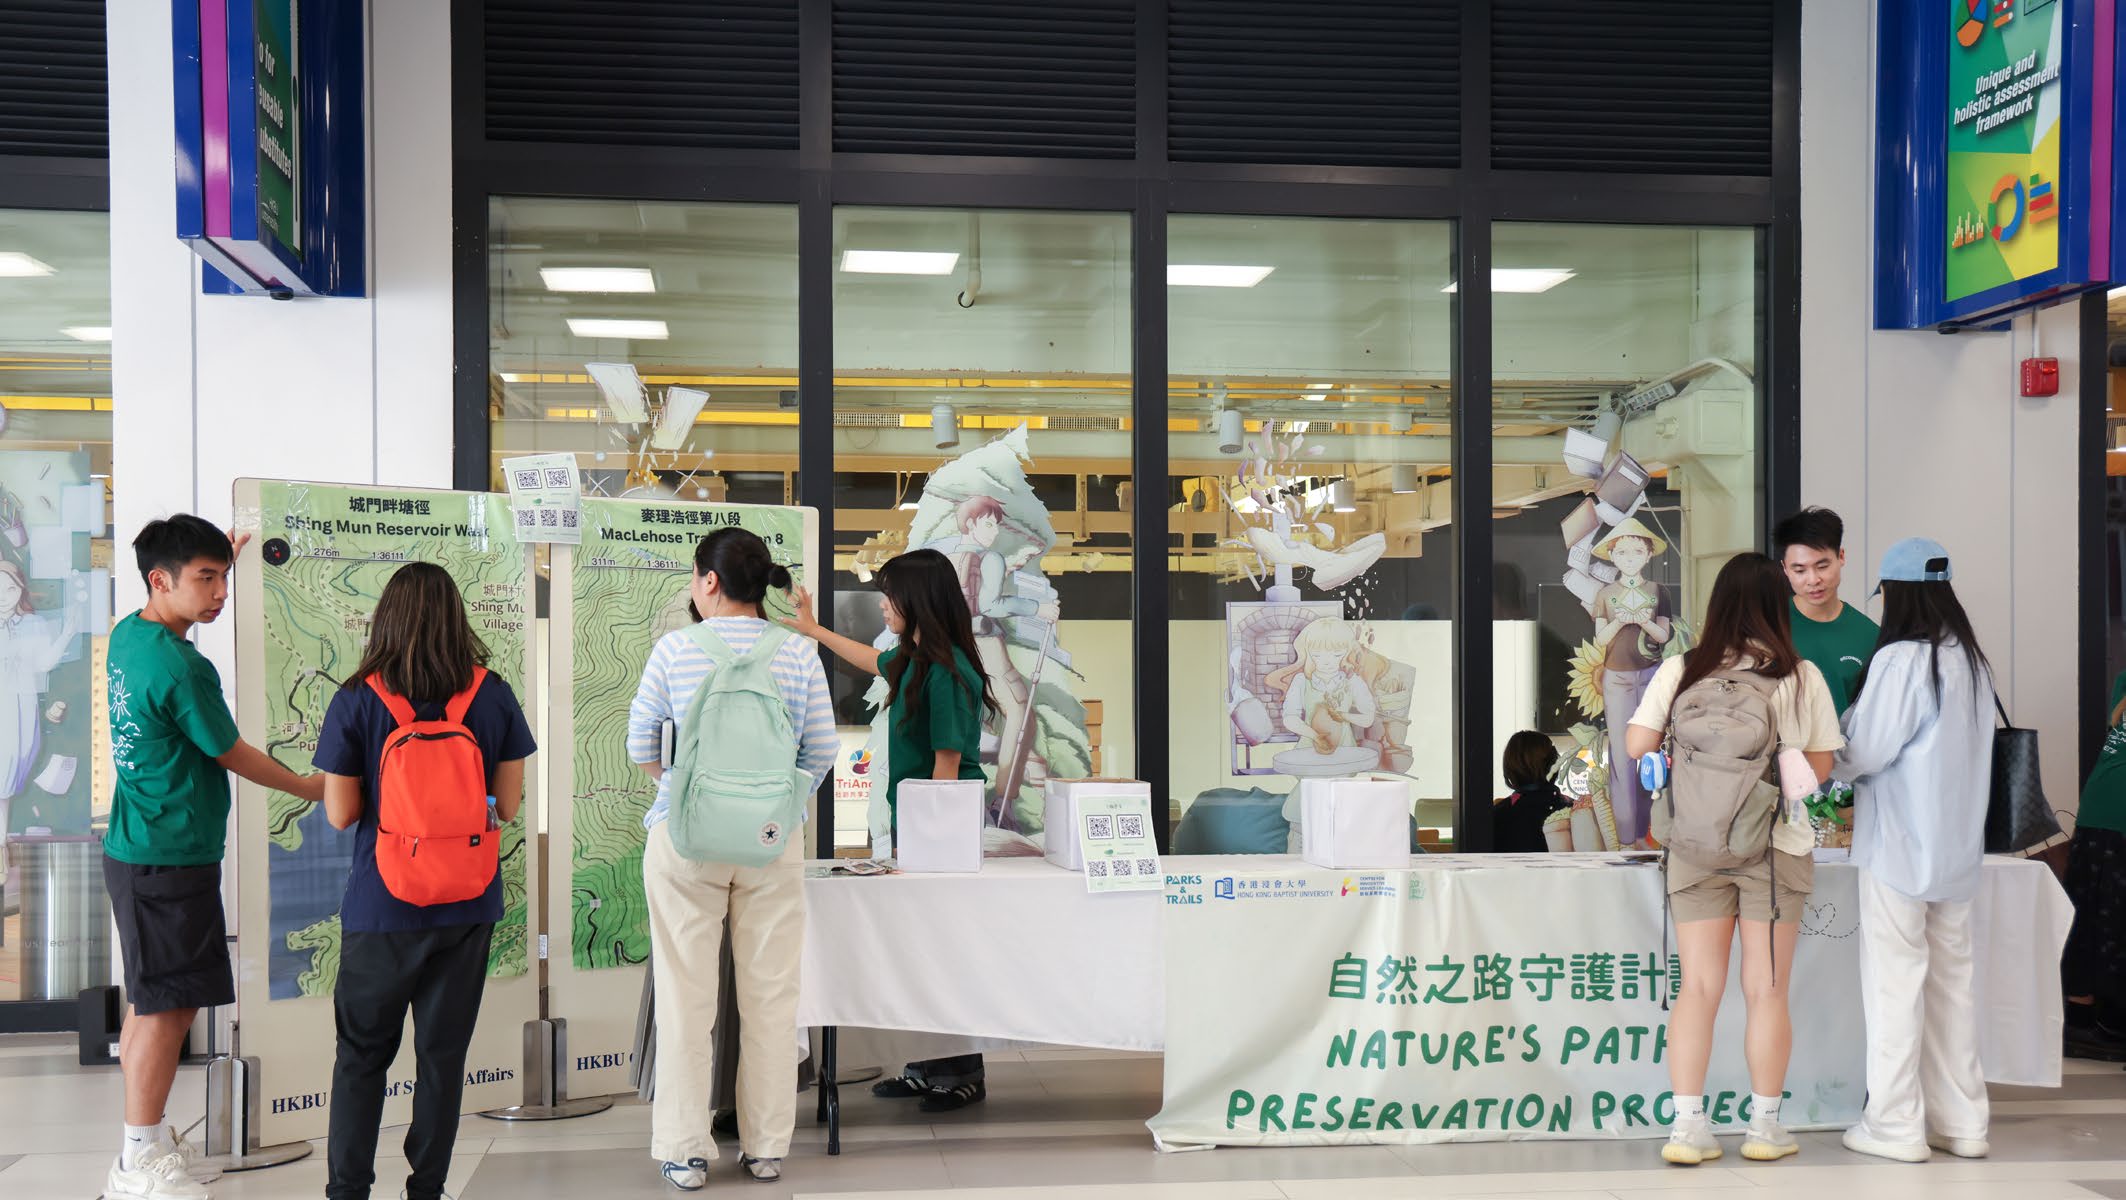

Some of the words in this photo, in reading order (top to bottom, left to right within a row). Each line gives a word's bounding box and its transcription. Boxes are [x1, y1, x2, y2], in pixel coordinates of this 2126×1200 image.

[1975, 65, 2012, 95] Unique
[2014, 49, 2036, 77] and
[1953, 94, 1992, 125] holistic
[1994, 62, 2060, 106] assessment
[1975, 93, 2034, 134] framework
[349, 496, 431, 516] 城門畔塘徑
[641, 508, 741, 526] 麥理浩徑第八段
[336, 519, 372, 535] Mun
[377, 522, 451, 538] Reservoir
[454, 524, 490, 538] Wa
[601, 528, 683, 544] MacLehose
[775, 533, 784, 545] 8
[314, 548, 340, 557] 276m
[372, 551, 404, 560] 1:36111
[591, 558, 616, 566] 311m
[647, 560, 679, 569] 1:36111
[471, 602, 504, 616] Shing
[483, 618, 524, 632] Village
[1165, 875, 1202, 885] PARKS
[1179, 886, 1187, 894] &
[1237, 891, 1254, 899] HONG
[1273, 890, 1298, 898] BAPTIST
[1299, 890, 1334, 898] UNIVERSITY
[1165, 895, 1203, 905] TRAILS
[1326, 1023, 1542, 1071] NATURE'S
[577, 1051, 626, 1071] HKBU
[271, 1091, 327, 1114] HKBU
[384, 1081, 401, 1098] of
[464, 1067, 514, 1086] Affairs
[1226, 1089, 1572, 1133] PRESERVATION
